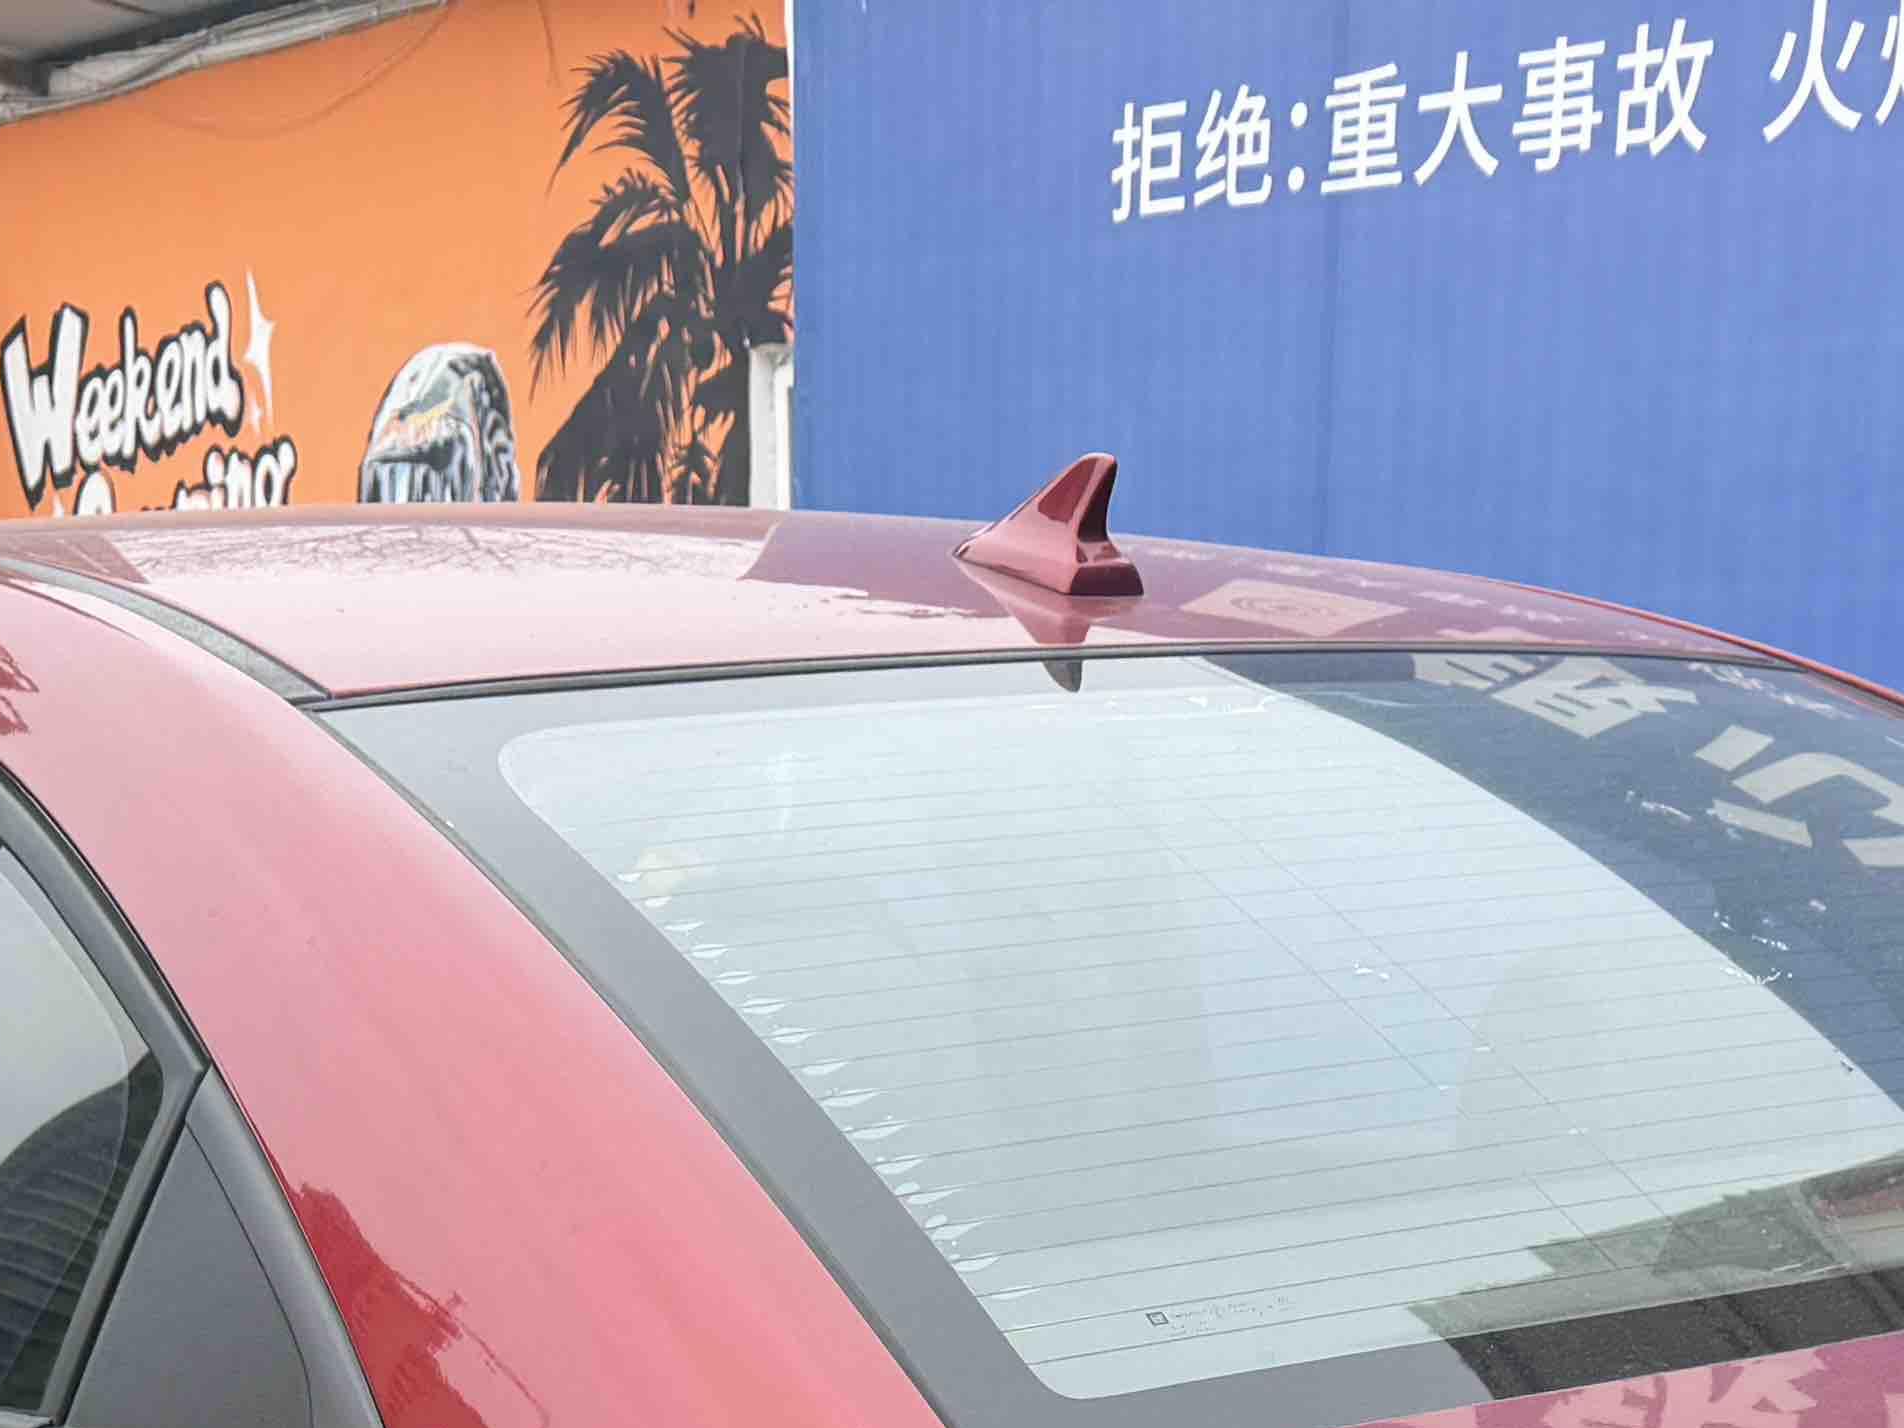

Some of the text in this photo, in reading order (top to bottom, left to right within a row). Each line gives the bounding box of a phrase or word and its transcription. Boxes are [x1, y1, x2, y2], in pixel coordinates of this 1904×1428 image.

[1109, 19, 1715, 224] 拒绝:重大事故
[0, 280, 244, 511] Weekend
